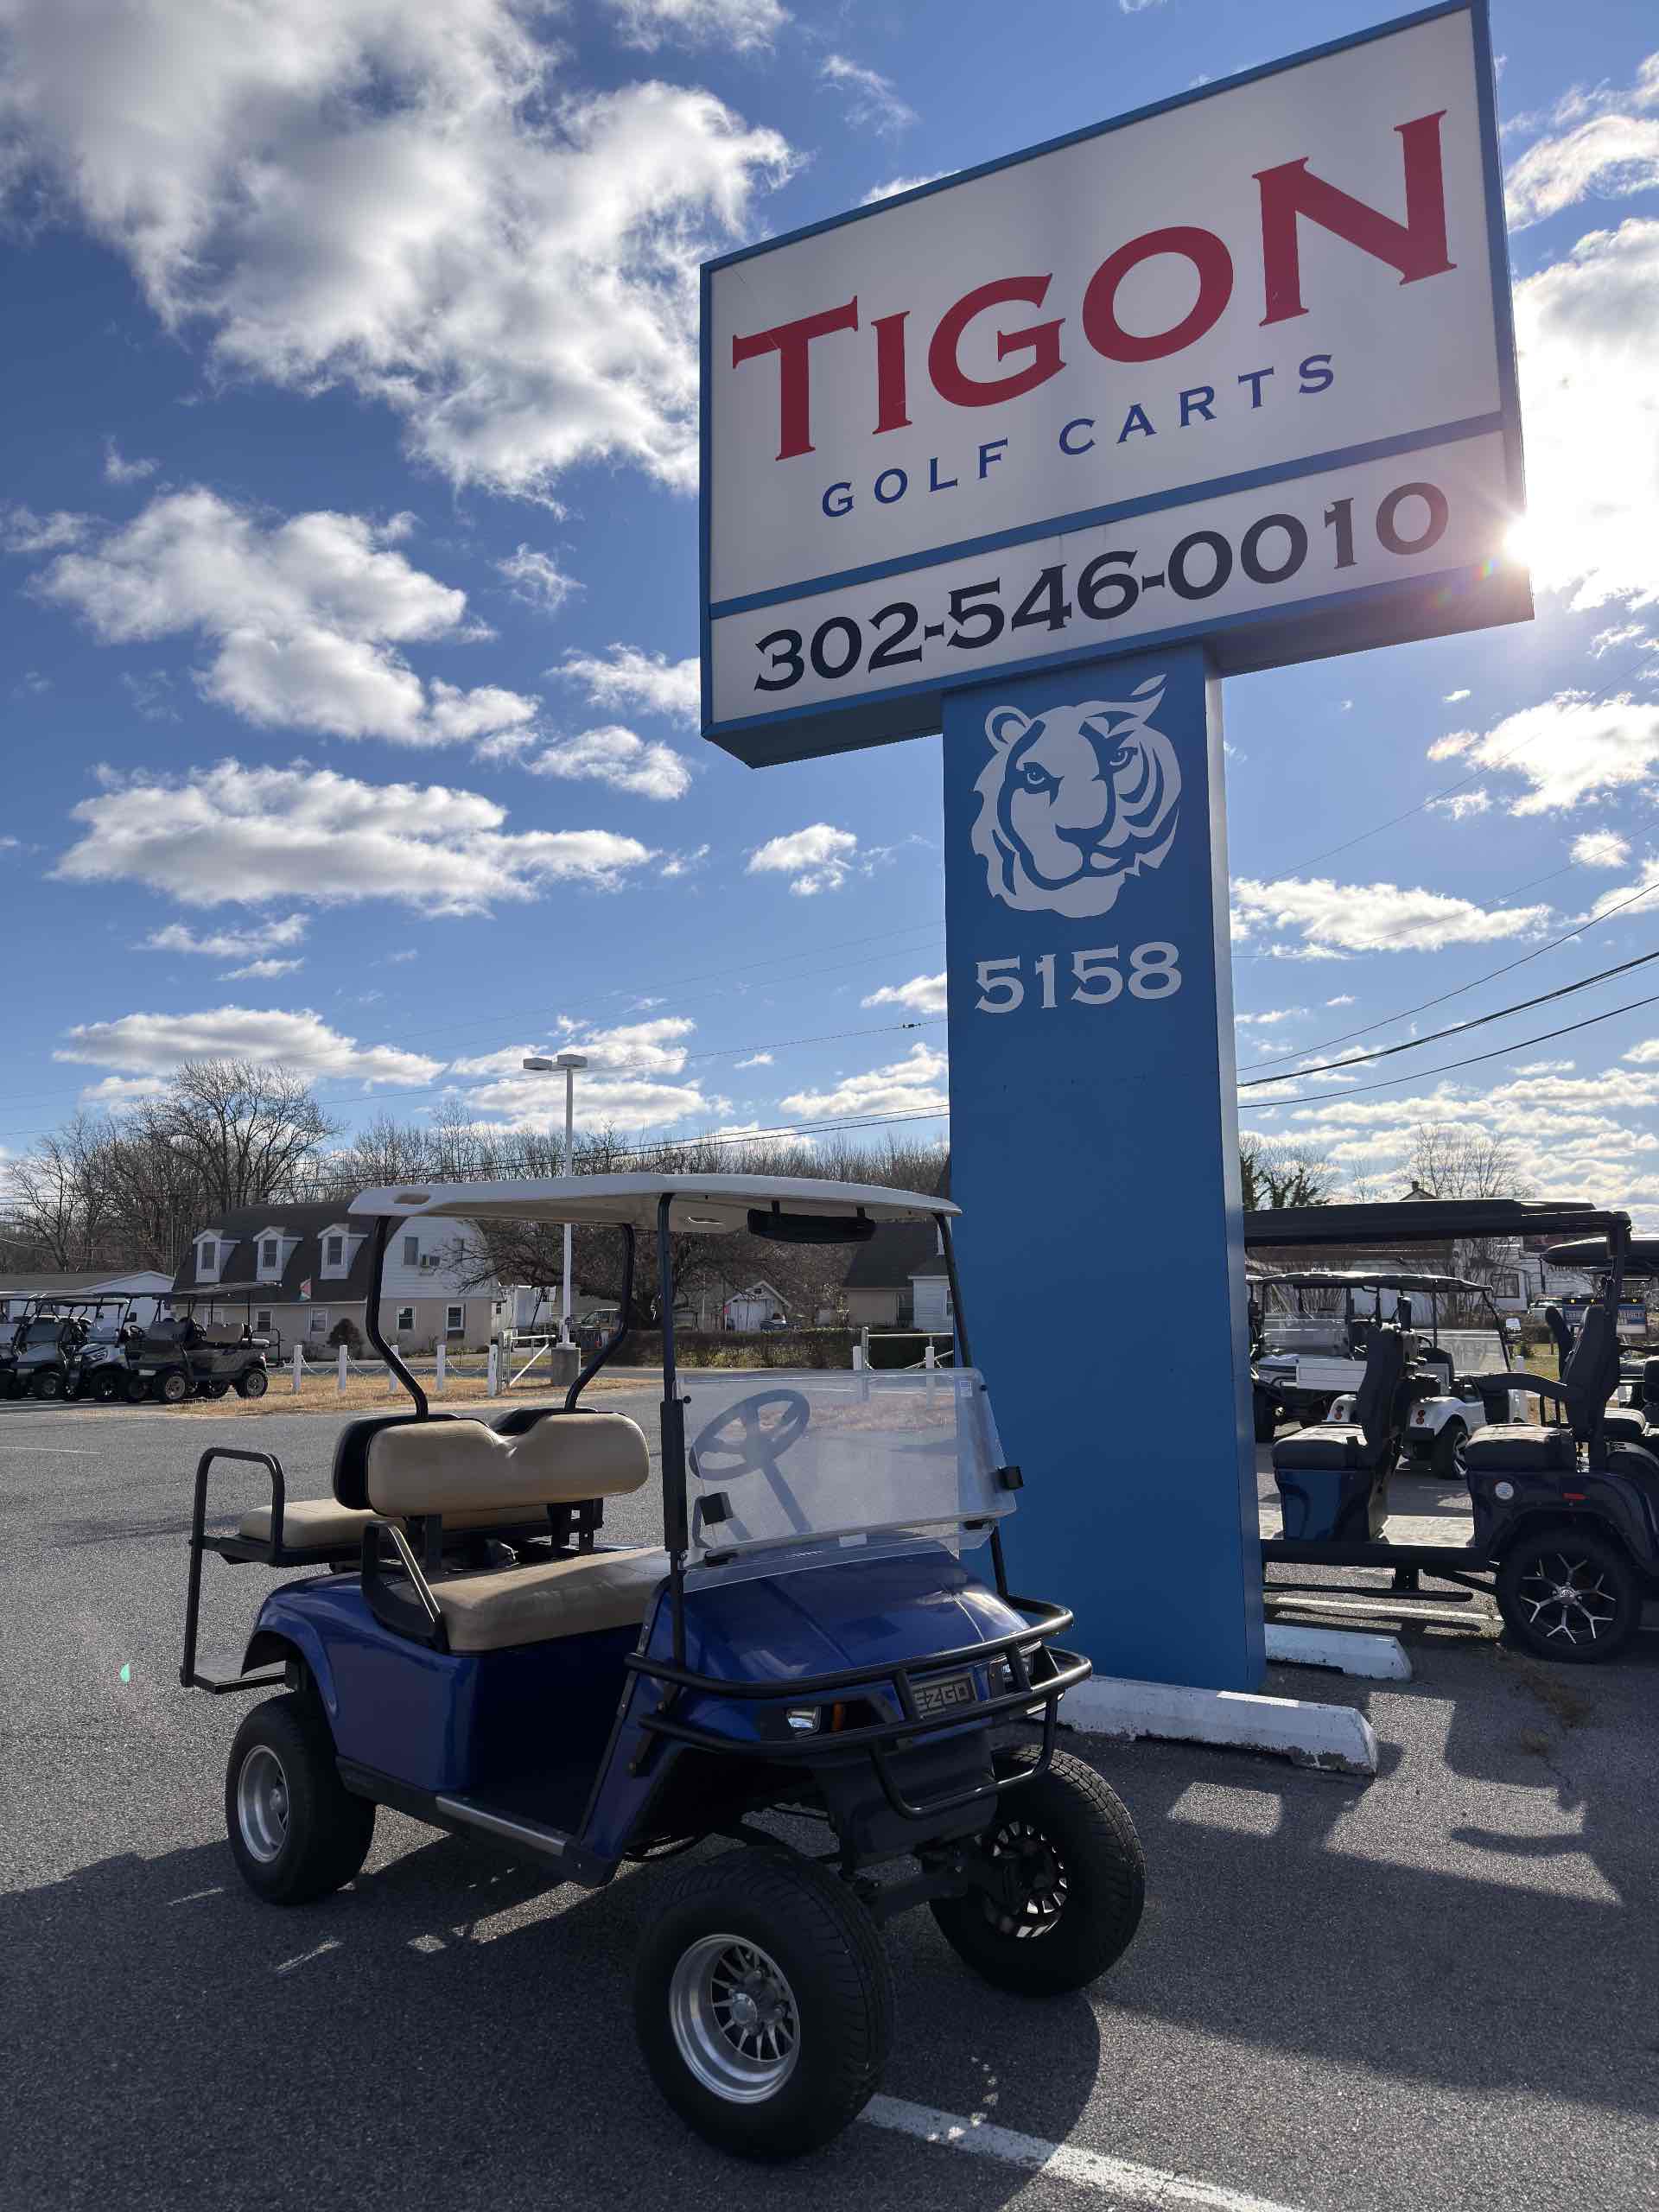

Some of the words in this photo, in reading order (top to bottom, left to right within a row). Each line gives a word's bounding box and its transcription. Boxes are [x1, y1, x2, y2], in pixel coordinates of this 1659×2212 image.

[733, 110, 1458, 461] TIGON
[822, 438, 1008, 518] GOLF
[1058, 354, 1335, 456] CARTS
[753, 481, 1449, 692] 302-546-0010
[976, 941, 1182, 1014] 5158
